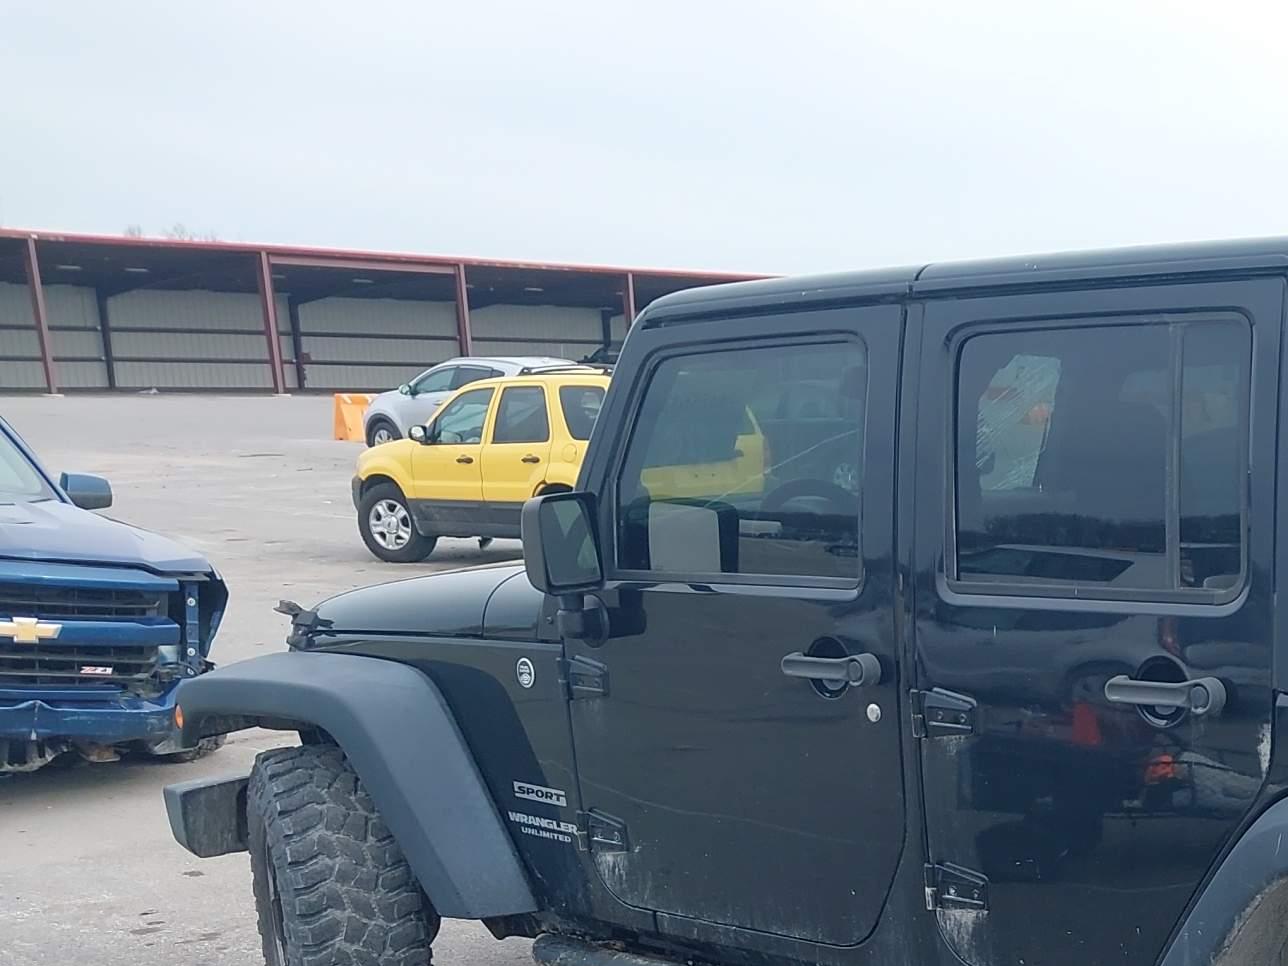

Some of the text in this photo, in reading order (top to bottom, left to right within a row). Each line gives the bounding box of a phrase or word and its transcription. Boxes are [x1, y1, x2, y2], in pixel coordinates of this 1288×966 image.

[516, 784, 565, 803] SPORT
[508, 811, 579, 836] WRANGLER
[521, 826, 572, 844] UNLIMITED
